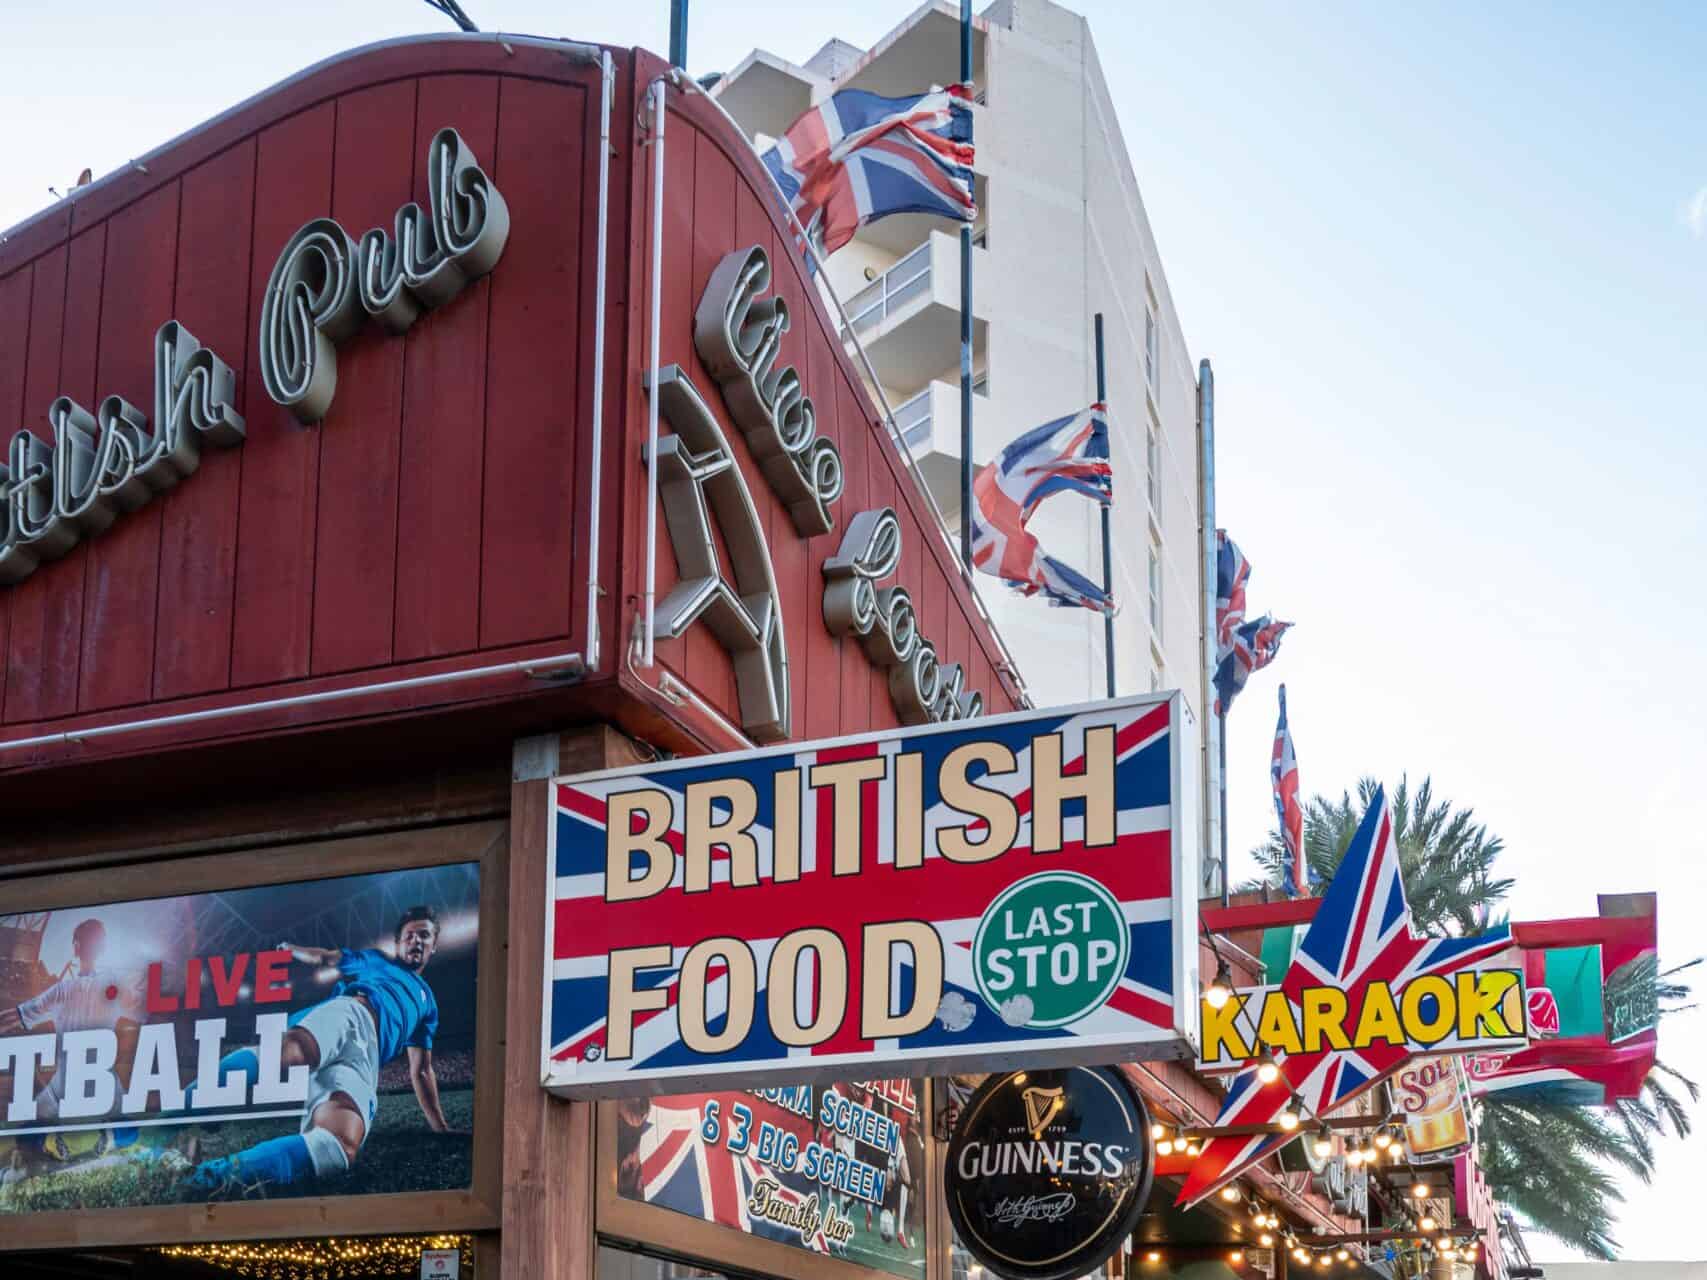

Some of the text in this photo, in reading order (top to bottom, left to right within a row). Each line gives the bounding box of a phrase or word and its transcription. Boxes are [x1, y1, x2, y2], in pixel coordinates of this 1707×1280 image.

[262, 128, 510, 423] Pub
[605, 724, 1118, 902] BRITISH
[1005, 902, 1100, 940] LAST
[146, 950, 292, 1013] LIVE
[605, 920, 944, 1060] FOOD
[987, 939, 1117, 990] STOP
[0, 1012, 310, 1123] TBALL
[728, 1102, 753, 1154] 3
[757, 1121, 799, 1172] BIG
[804, 1142, 887, 1206] SCREEN
[820, 1090, 901, 1156] SCREEN
[959, 1141, 1124, 1181] GUINNESS
[750, 1178, 855, 1244] Family bar
